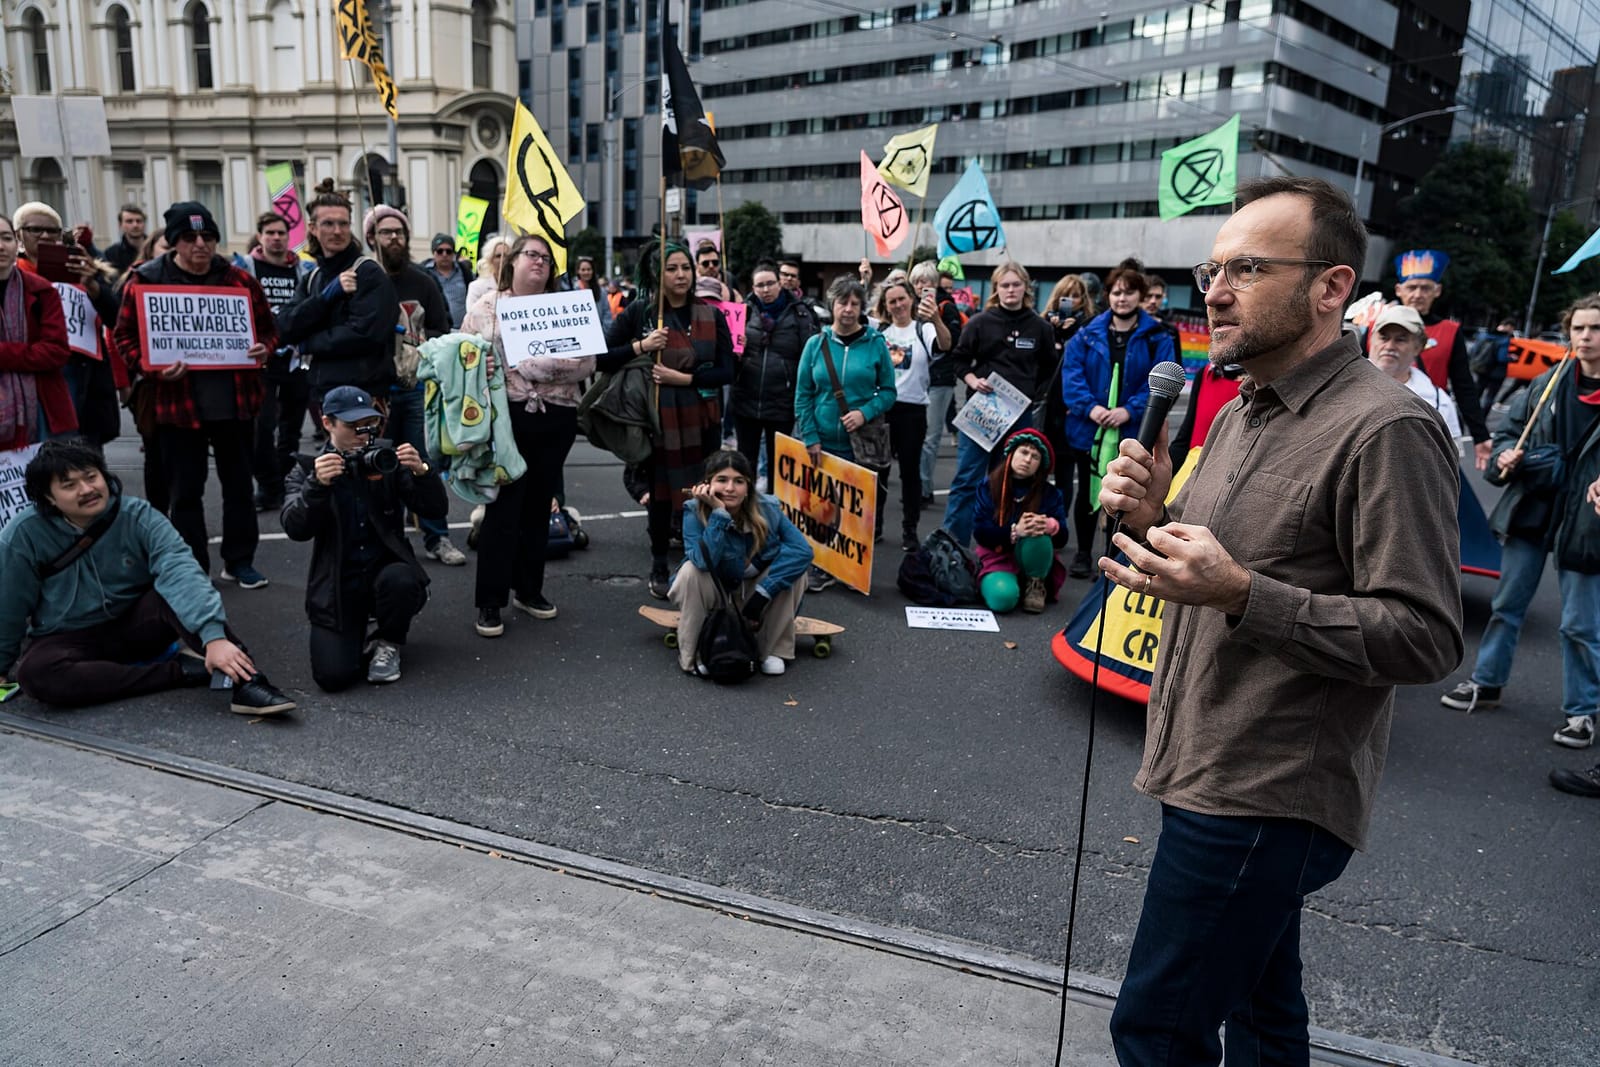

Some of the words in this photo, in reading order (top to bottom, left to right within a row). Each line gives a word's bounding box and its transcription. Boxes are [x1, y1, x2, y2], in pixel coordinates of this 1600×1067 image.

[260, 277, 295, 288] OCCUPY
[148, 296, 194, 314] BUILD
[198, 297, 246, 316] PUBLIC
[501, 309, 530, 321] MORE
[532, 306, 559, 318] COAL
[562, 305, 569, 315] &
[572, 302, 593, 313] GAS
[150, 314, 248, 333] RENEWABLES
[521, 320, 548, 332] MASS
[552, 316, 591, 329] MURDER
[152, 338, 175, 350] NOT
[176, 338, 224, 350] NUCLEAR
[226, 338, 250, 350] SUBS
[778, 454, 864, 518] CLIMATE
[1123, 590, 1163, 620] CLI
